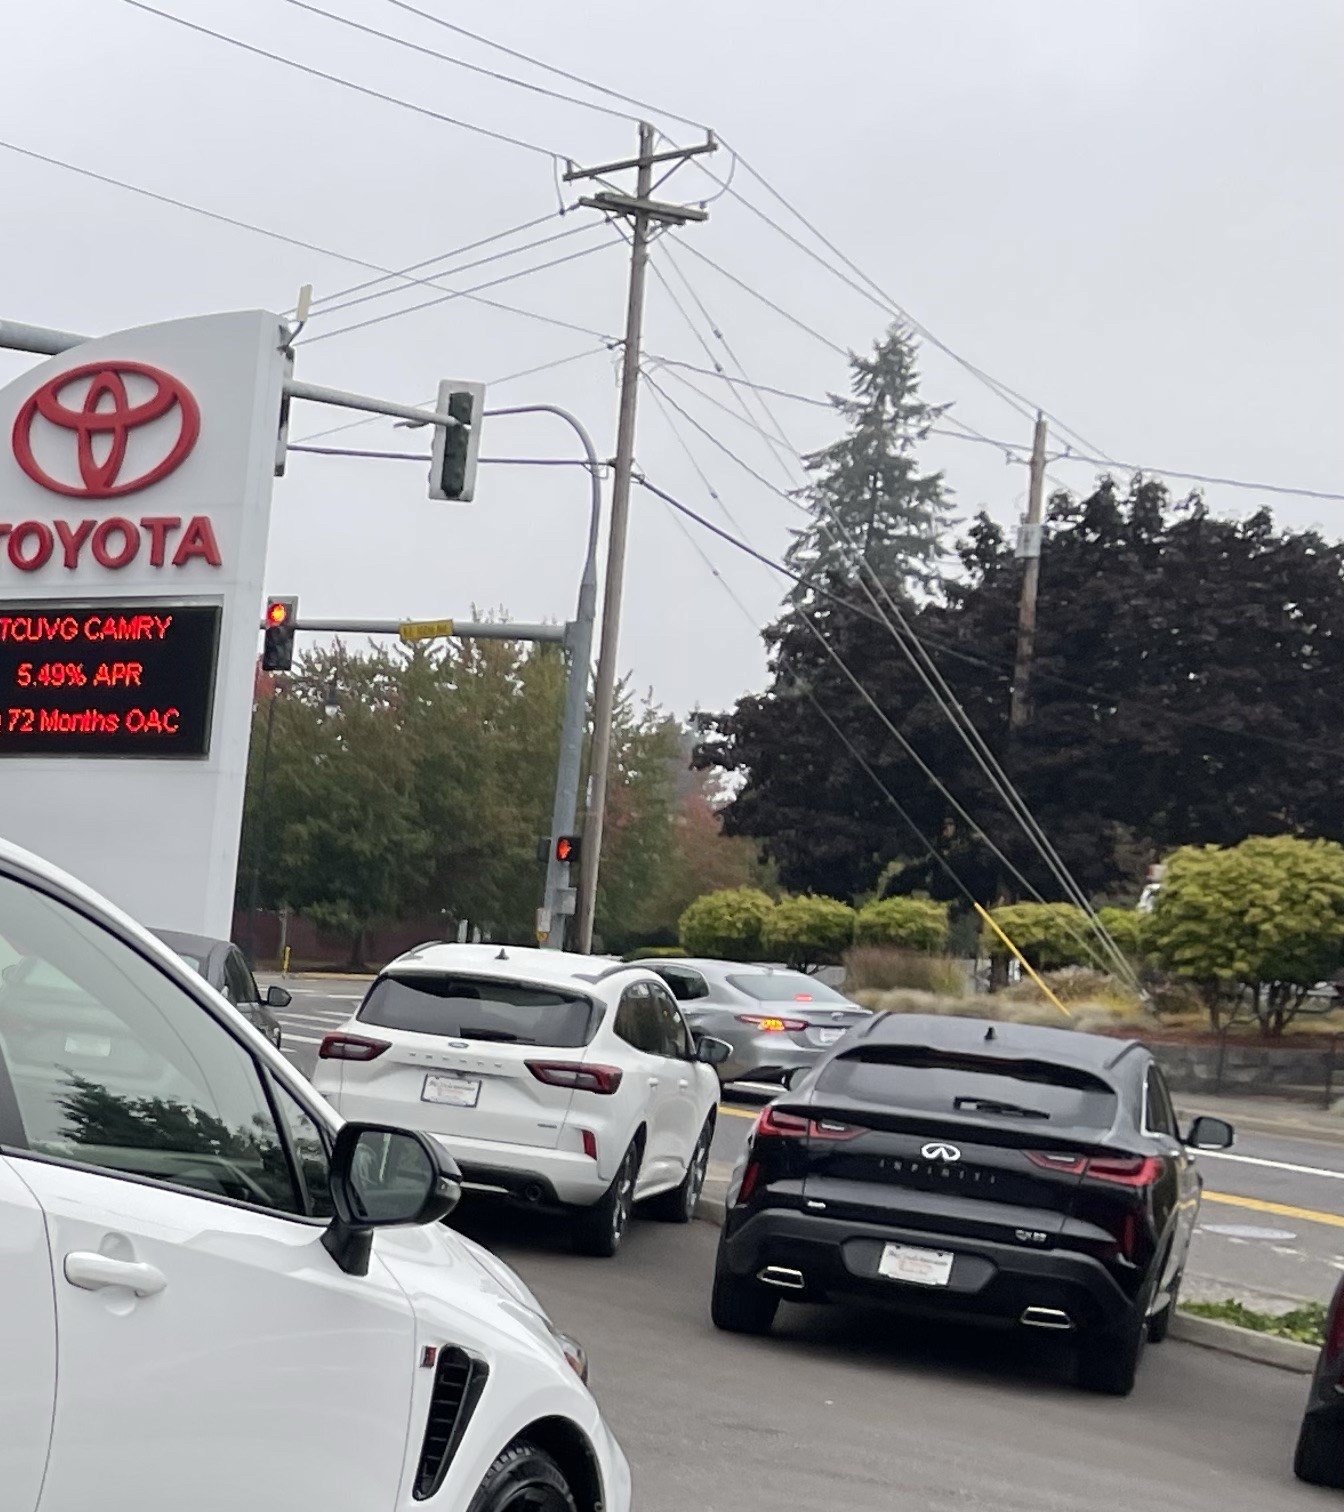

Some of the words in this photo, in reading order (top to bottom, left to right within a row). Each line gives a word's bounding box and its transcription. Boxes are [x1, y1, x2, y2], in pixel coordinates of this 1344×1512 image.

[84, 614, 173, 641] CAMRY
[17, 662, 87, 687] 5.49%
[92, 662, 143, 687] APR
[8, 708, 35, 732] 72
[40, 708, 120, 733] Months
[125, 708, 181, 733] OAC
